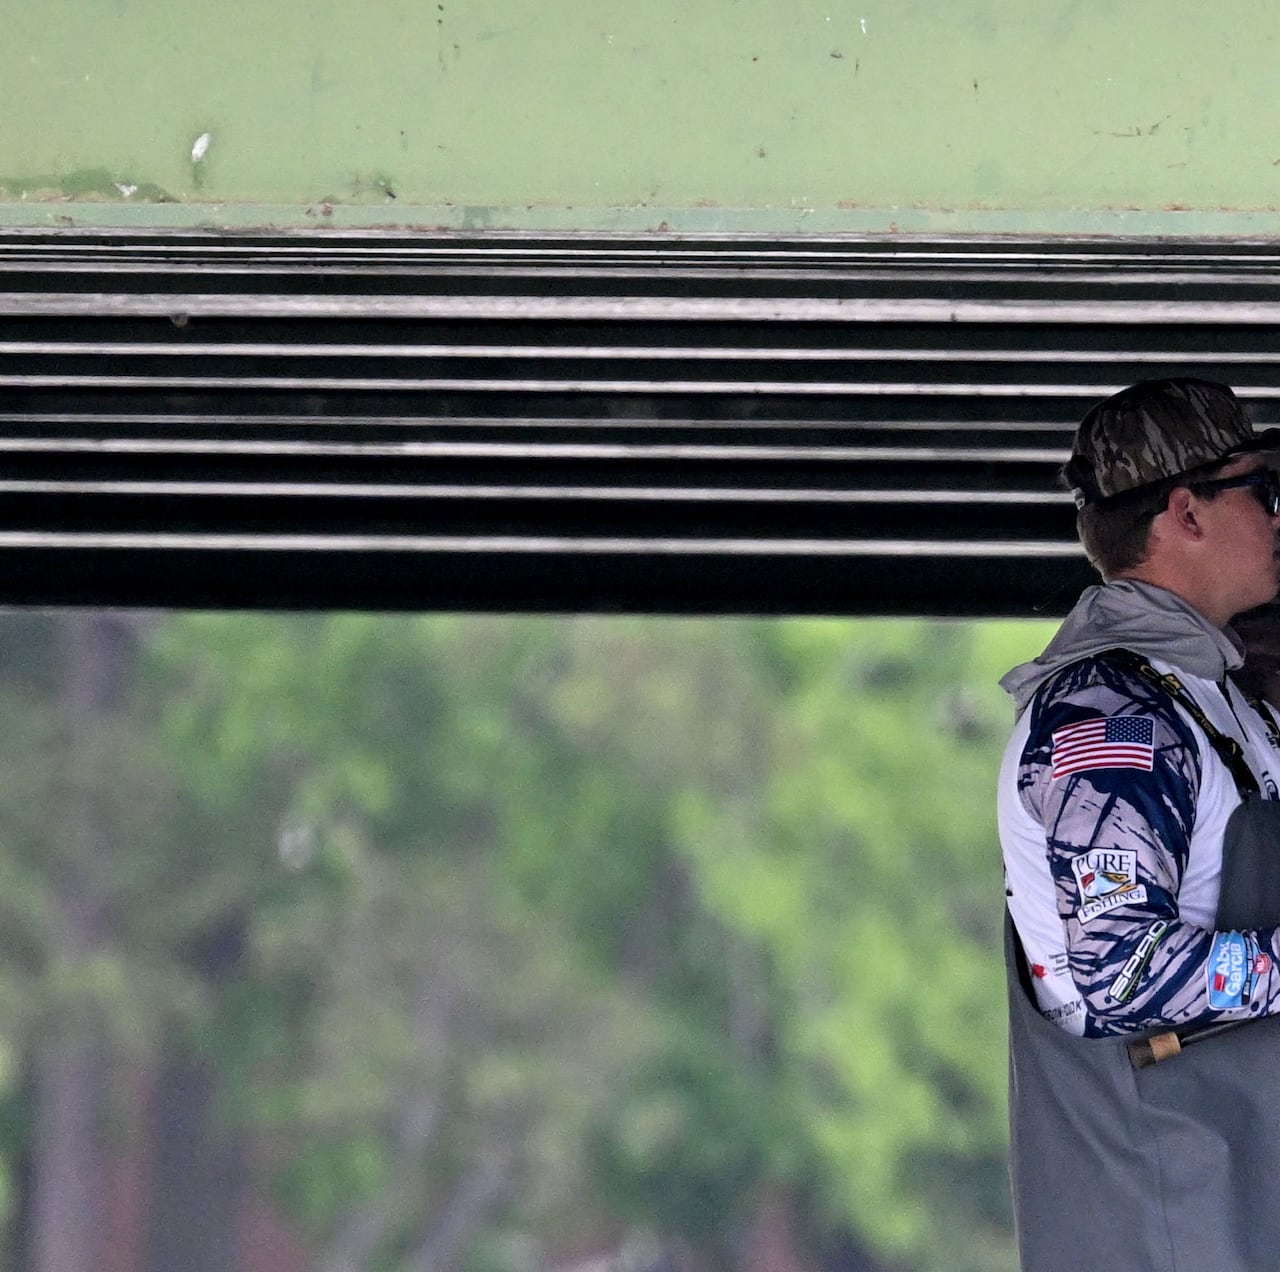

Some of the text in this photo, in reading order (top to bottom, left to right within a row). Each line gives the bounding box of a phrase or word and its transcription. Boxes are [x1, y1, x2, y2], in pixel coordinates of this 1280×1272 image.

[1076, 853, 1131, 875] PURE
[1109, 919, 1168, 999] SPRO
[1224, 942, 1244, 997] Garcia
